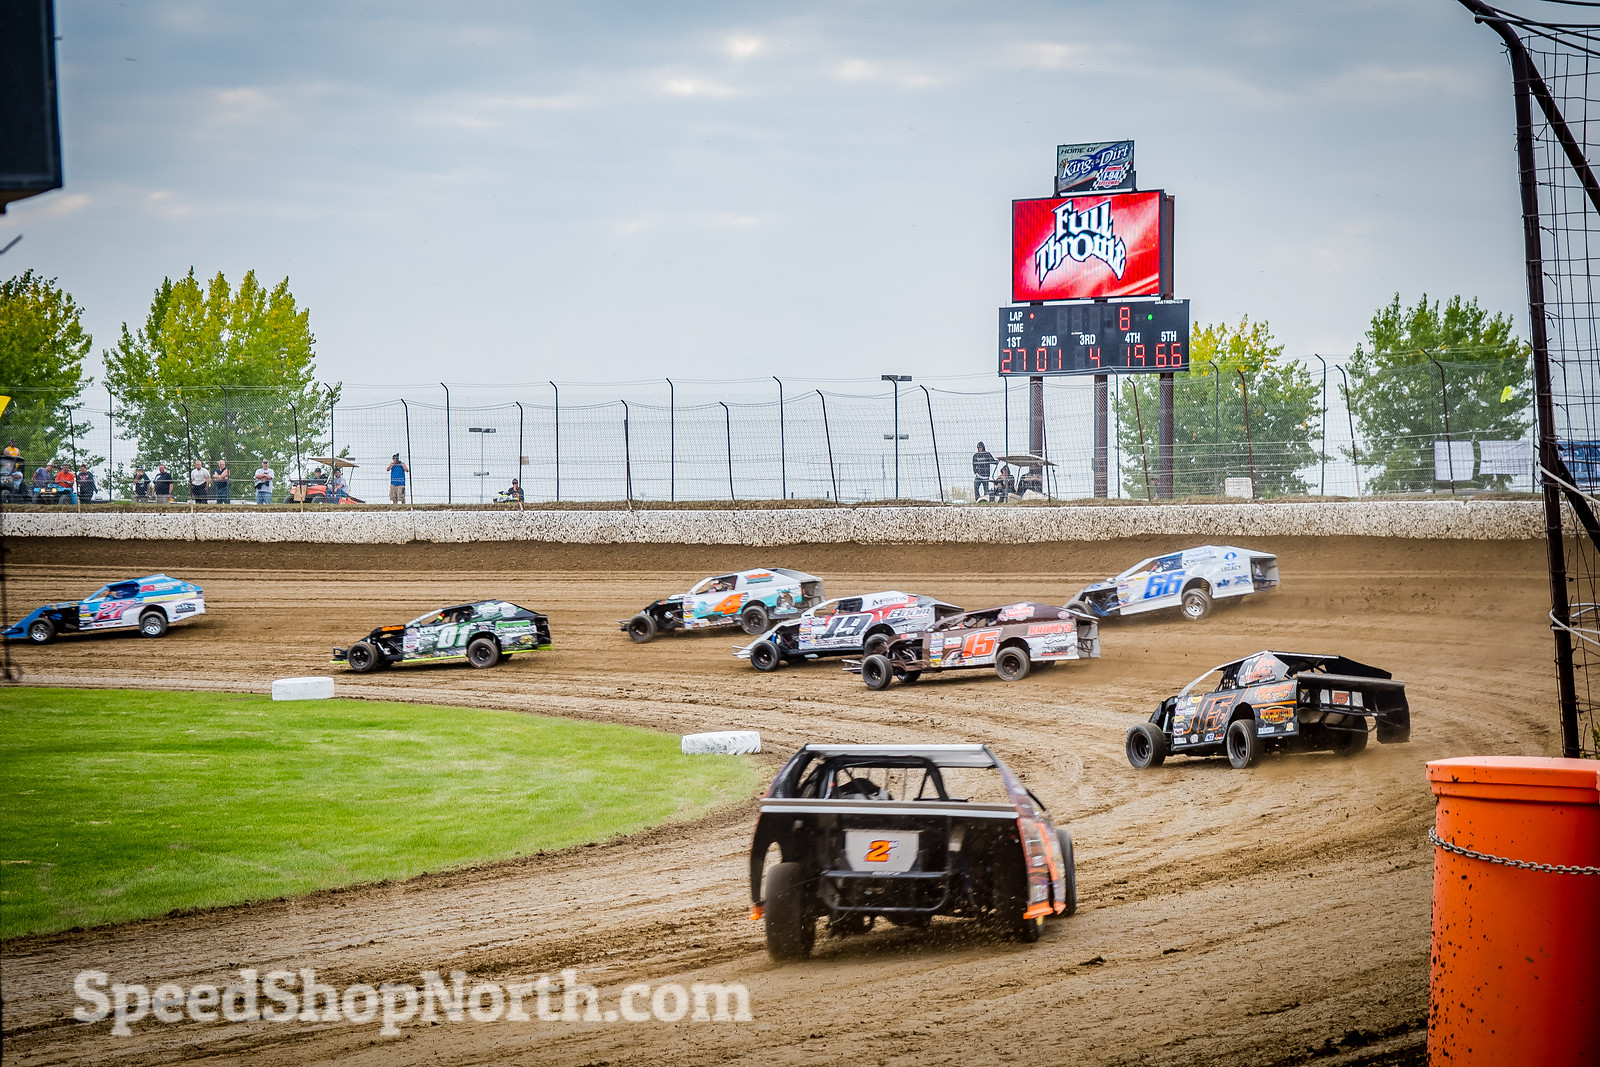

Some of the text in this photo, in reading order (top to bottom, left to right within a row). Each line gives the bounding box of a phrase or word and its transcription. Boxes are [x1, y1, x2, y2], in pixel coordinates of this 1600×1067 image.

[1060, 158, 1093, 179] King
[1099, 144, 1129, 167] Dirt
[1061, 146, 1086, 155] HOME
[1103, 171, 1120, 180] I-94
[1052, 199, 1113, 241] Full
[1007, 322, 1024, 333] TIME
[1009, 311, 1023, 321] LAP
[1119, 306, 1131, 331] 8
[1006, 330, 1177, 348] 1ST 2ND 3RD 4TH 5TH
[1001, 342, 1182, 373] 27 01 4 19 66
[1143, 570, 1186, 600] 66
[96, 599, 134, 621] 27
[713, 592, 748, 615] 4
[436, 625, 470, 649] 01
[822, 615, 868, 639] 19
[962, 631, 999, 658] 15
[864, 839, 891, 863] 2
